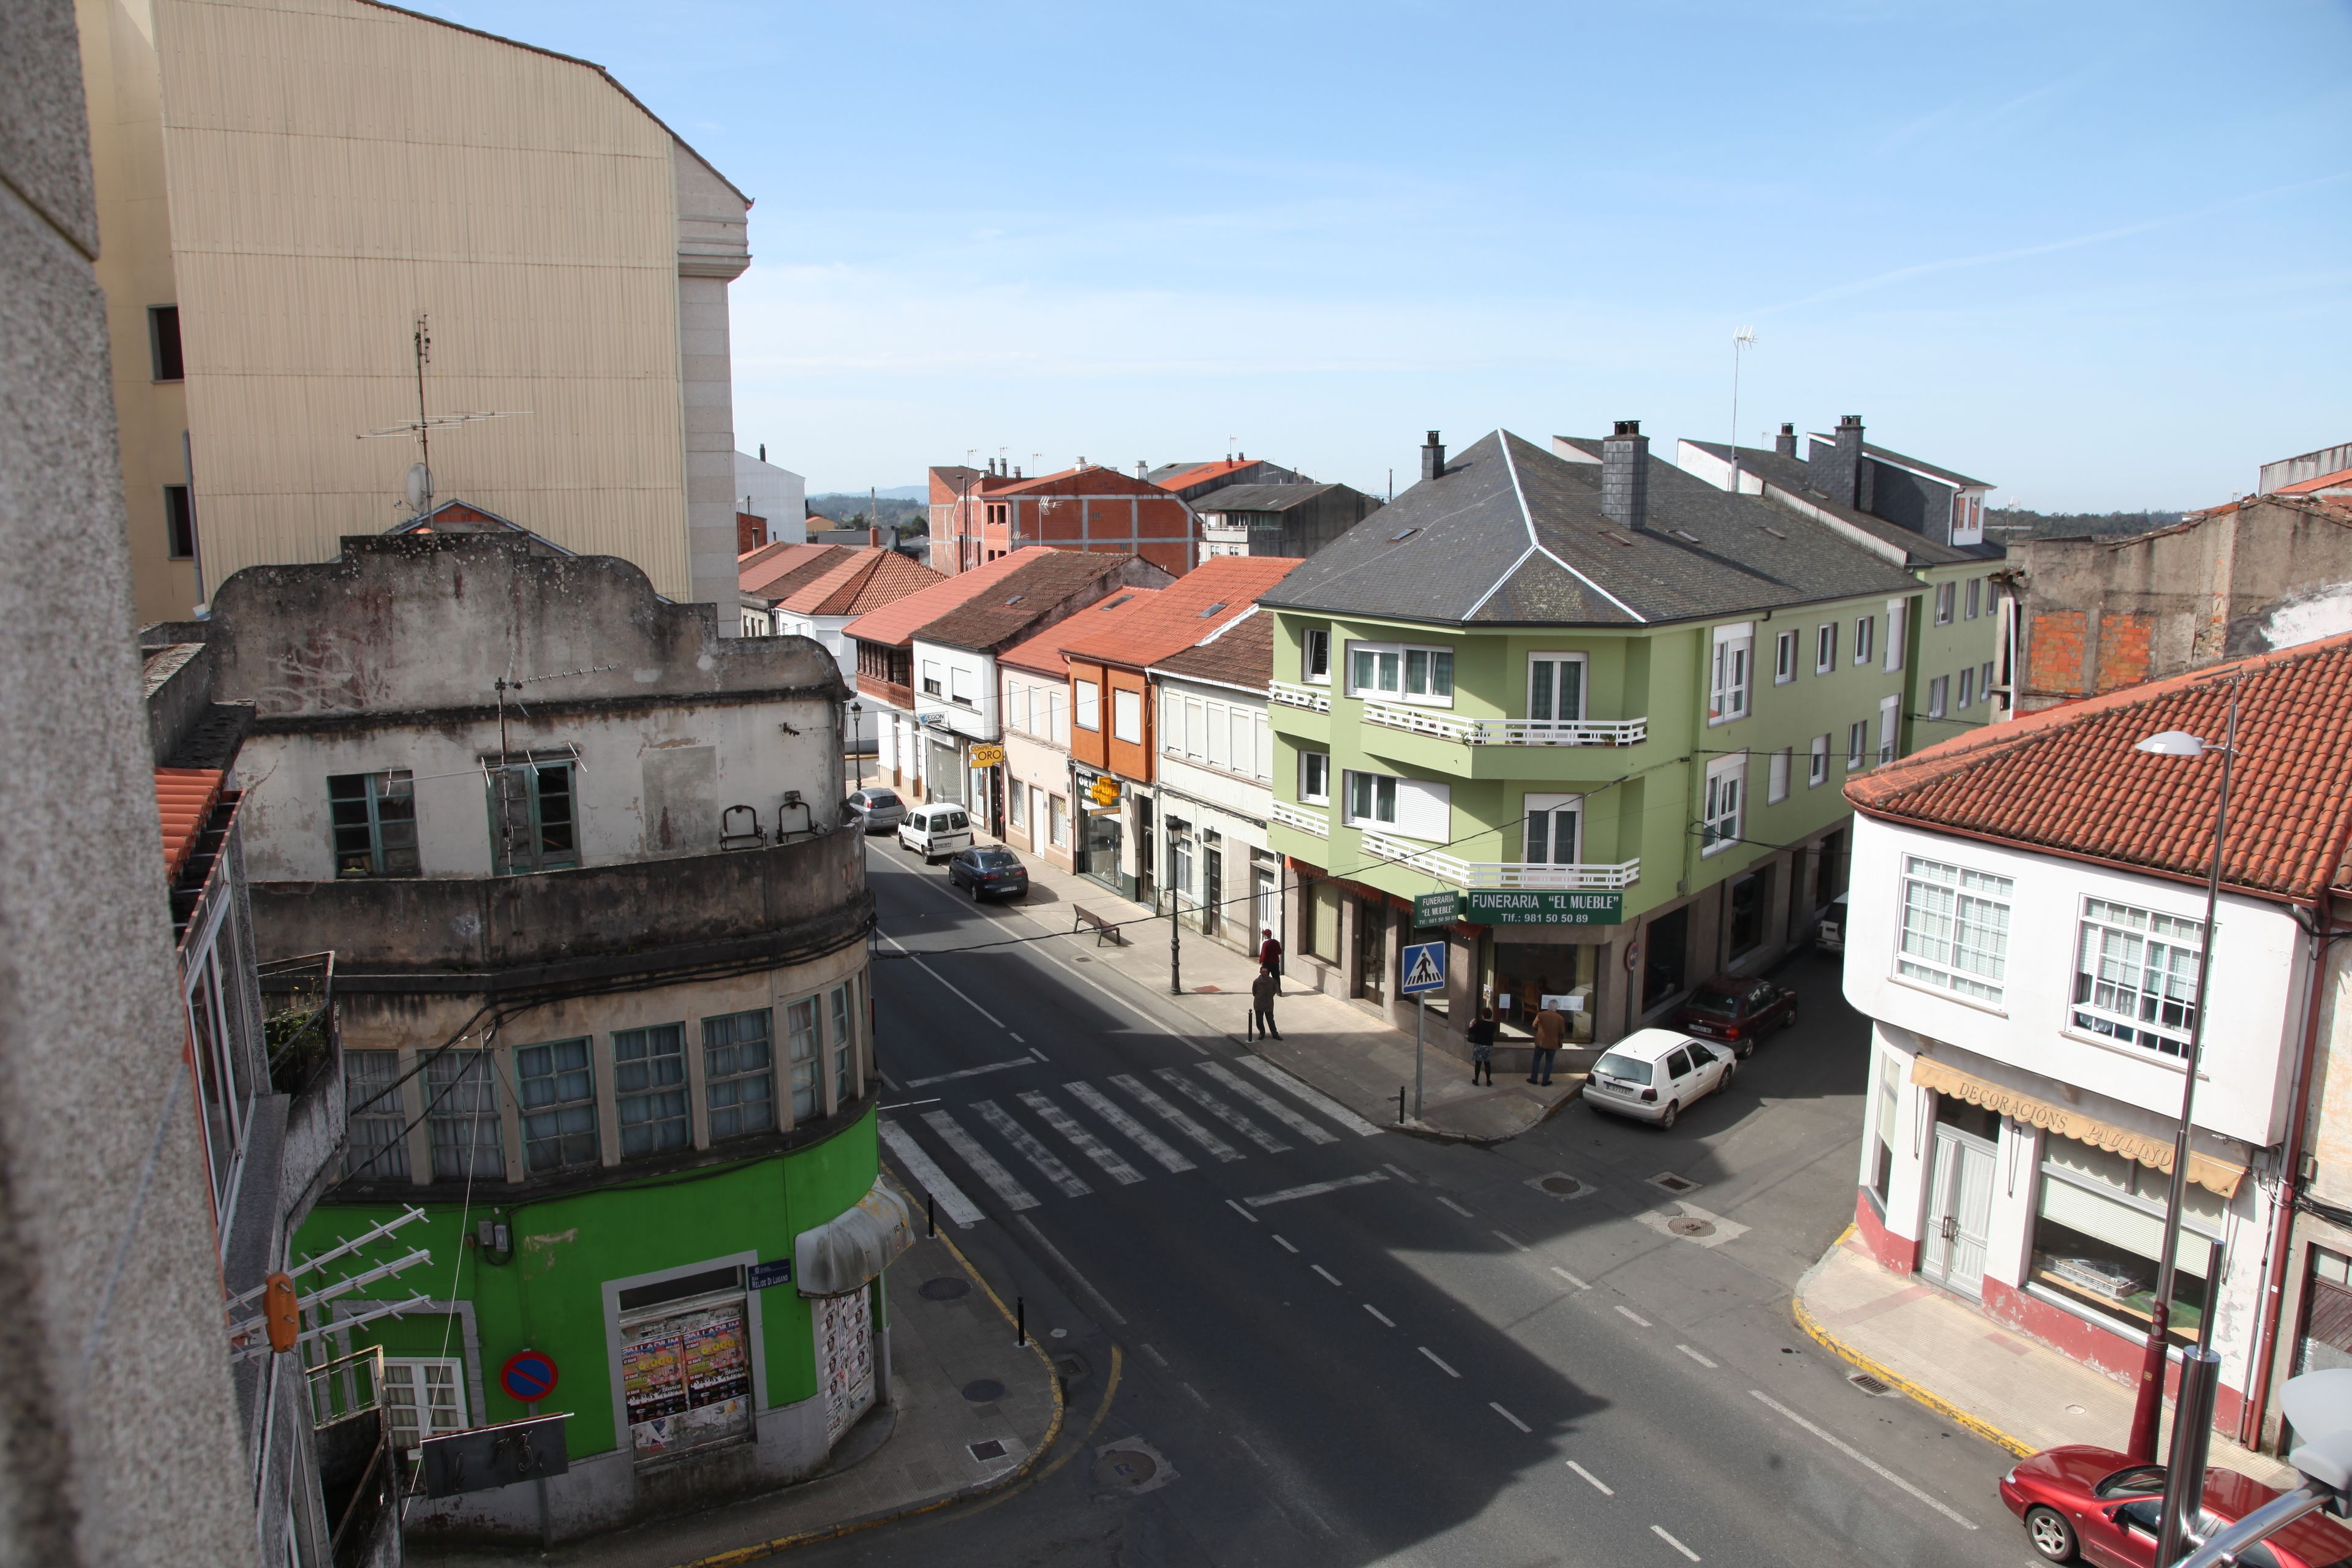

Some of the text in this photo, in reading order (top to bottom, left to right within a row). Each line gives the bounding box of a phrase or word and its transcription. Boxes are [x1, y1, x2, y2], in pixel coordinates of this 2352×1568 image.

[978, 750, 1001, 760] ORO
[1075, 767, 1091, 777] ORTOPEDIA
[1422, 895, 1454, 906] FUNERARIA
[1472, 894, 1539, 908] FUNERARIA
[1525, 913, 1542, 922] 981
[1546, 914, 1558, 922] 50
[1561, 914, 1573, 922] 50
[1576, 914, 1588, 922] 89
[1959, 1082, 2172, 1166] DECORACIÓNS PAULINO
[684, 1336, 706, 1345] DISCOTECA
[724, 1366, 744, 1375] Blanca
[662, 1384, 682, 1392] Blanca
